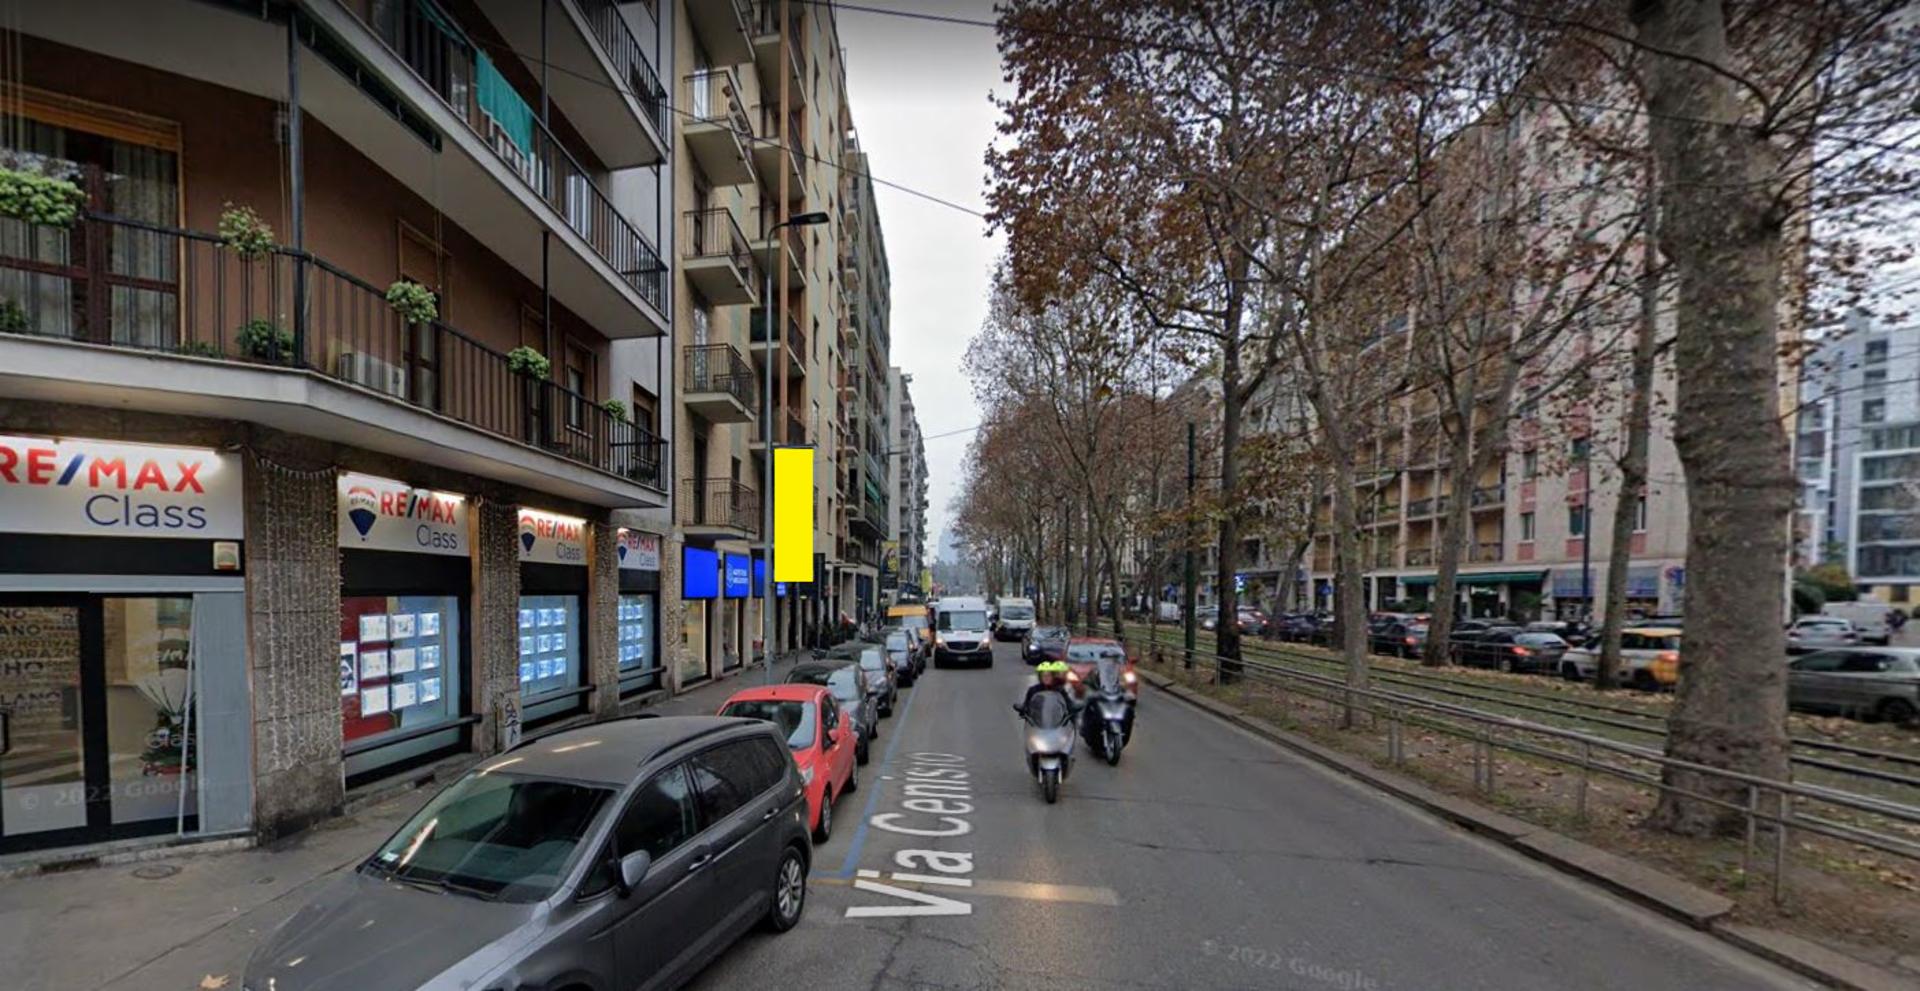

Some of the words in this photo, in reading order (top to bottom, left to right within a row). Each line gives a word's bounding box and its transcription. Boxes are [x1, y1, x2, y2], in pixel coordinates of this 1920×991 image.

[0, 446, 205, 493] RE/MAX
[85, 494, 207, 530] Class
[380, 491, 457, 526] RE/MAX
[416, 524, 458, 550] Class
[537, 518, 581, 541] RE/MAX
[628, 533, 656, 552] RE/MAX
[556, 541, 581, 560] Class
